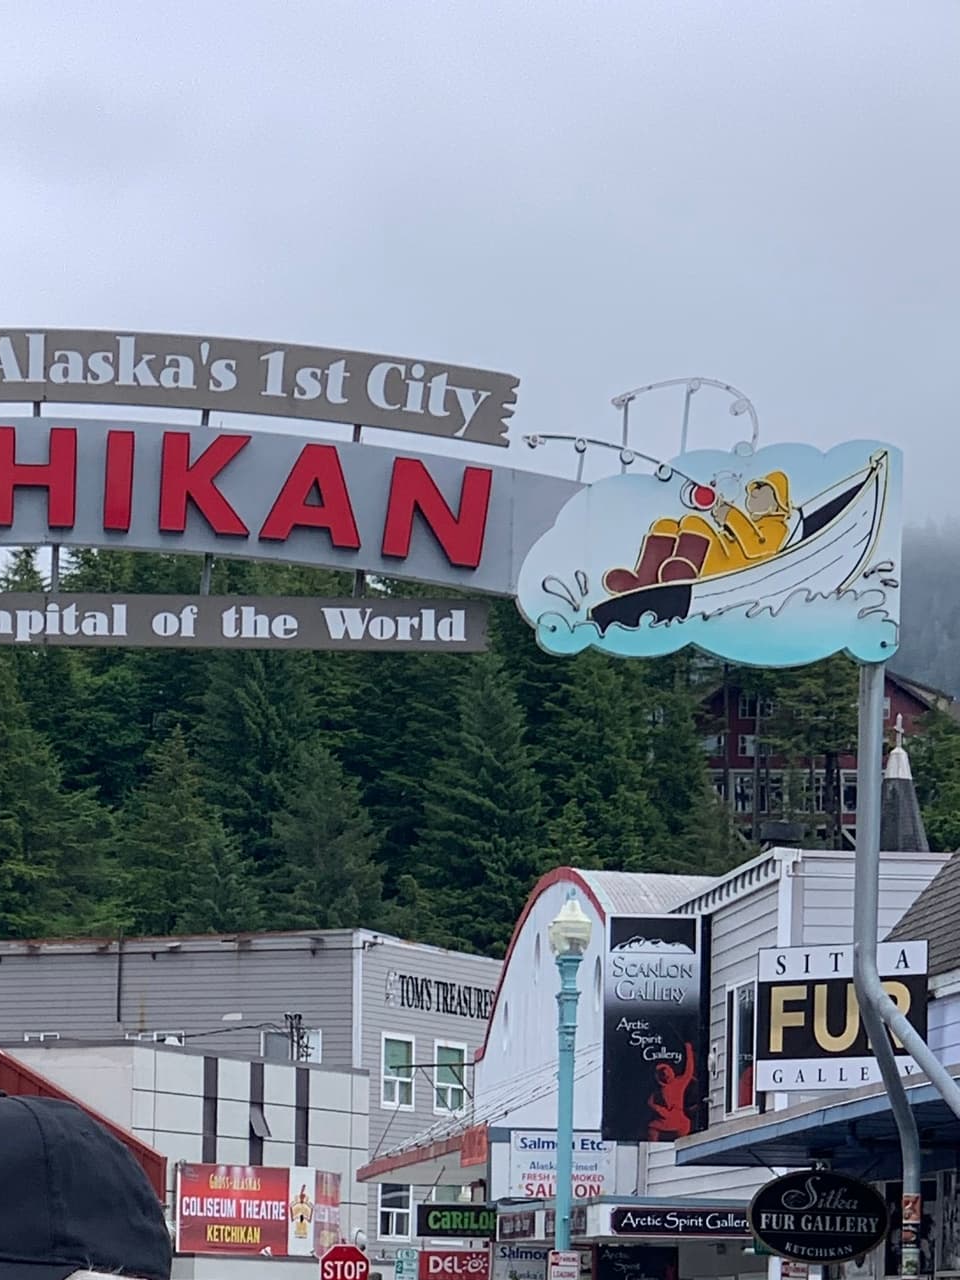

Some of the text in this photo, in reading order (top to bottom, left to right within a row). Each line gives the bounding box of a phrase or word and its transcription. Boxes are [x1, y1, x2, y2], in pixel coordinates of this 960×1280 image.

[259, 350, 350, 404] 1st
[367, 360, 491, 437] City
[152, 605, 199, 638] of
[221, 605, 298, 641] the
[321, 607, 466, 643] World
[776, 948, 910, 975] SITA
[399, 974, 432, 1011] TOM'S
[616, 1017, 649, 1031] Arctic
[629, 1031, 662, 1048] Spirit
[643, 1046, 682, 1063] Gallery
[772, 1065, 914, 1084] GALLEY
[519, 1137, 607, 1151] Salm Etc.
[571, 1173, 604, 1181] MOKED
[525, 1183, 601, 1198] SALON
[781, 1176, 858, 1210] Sitka
[182, 1196, 286, 1221] COLISEUM THEATRE
[621, 1212, 663, 1228] Arctic
[664, 1212, 703, 1231] Spirit
[760, 1213, 879, 1233] FUR GALLERY
[206, 1224, 261, 1244] KETCHIKAN
[784, 1242, 853, 1257] KETCHIKAN
[323, 1260, 367, 1280] STOP
